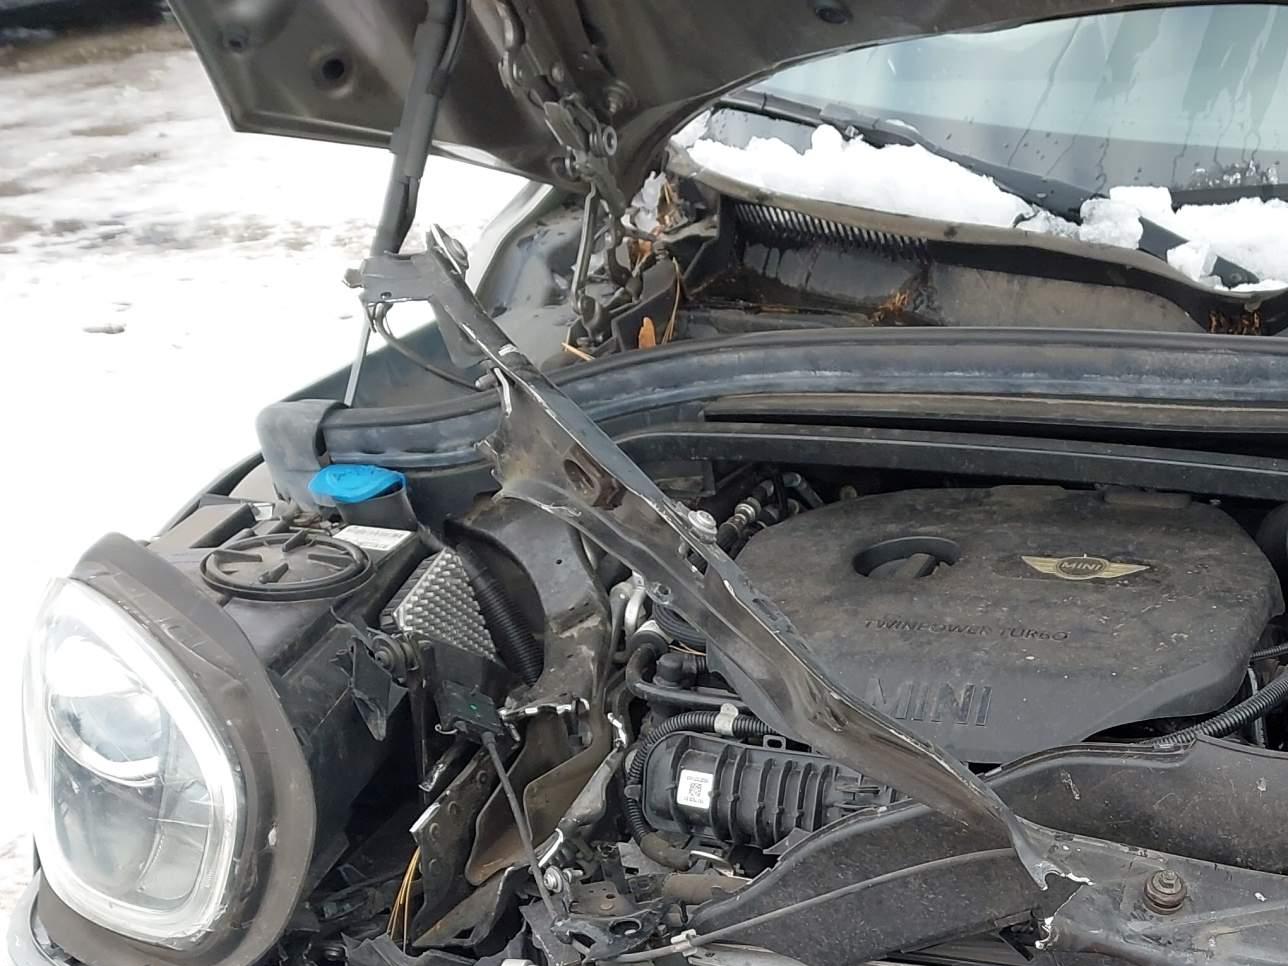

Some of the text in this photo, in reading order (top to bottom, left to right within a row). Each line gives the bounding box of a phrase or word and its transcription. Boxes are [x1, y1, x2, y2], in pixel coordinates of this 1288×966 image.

[1061, 562, 1102, 570] MINI
[1000, 627, 1070, 641] TURBO
[864, 678, 992, 726] MINI
